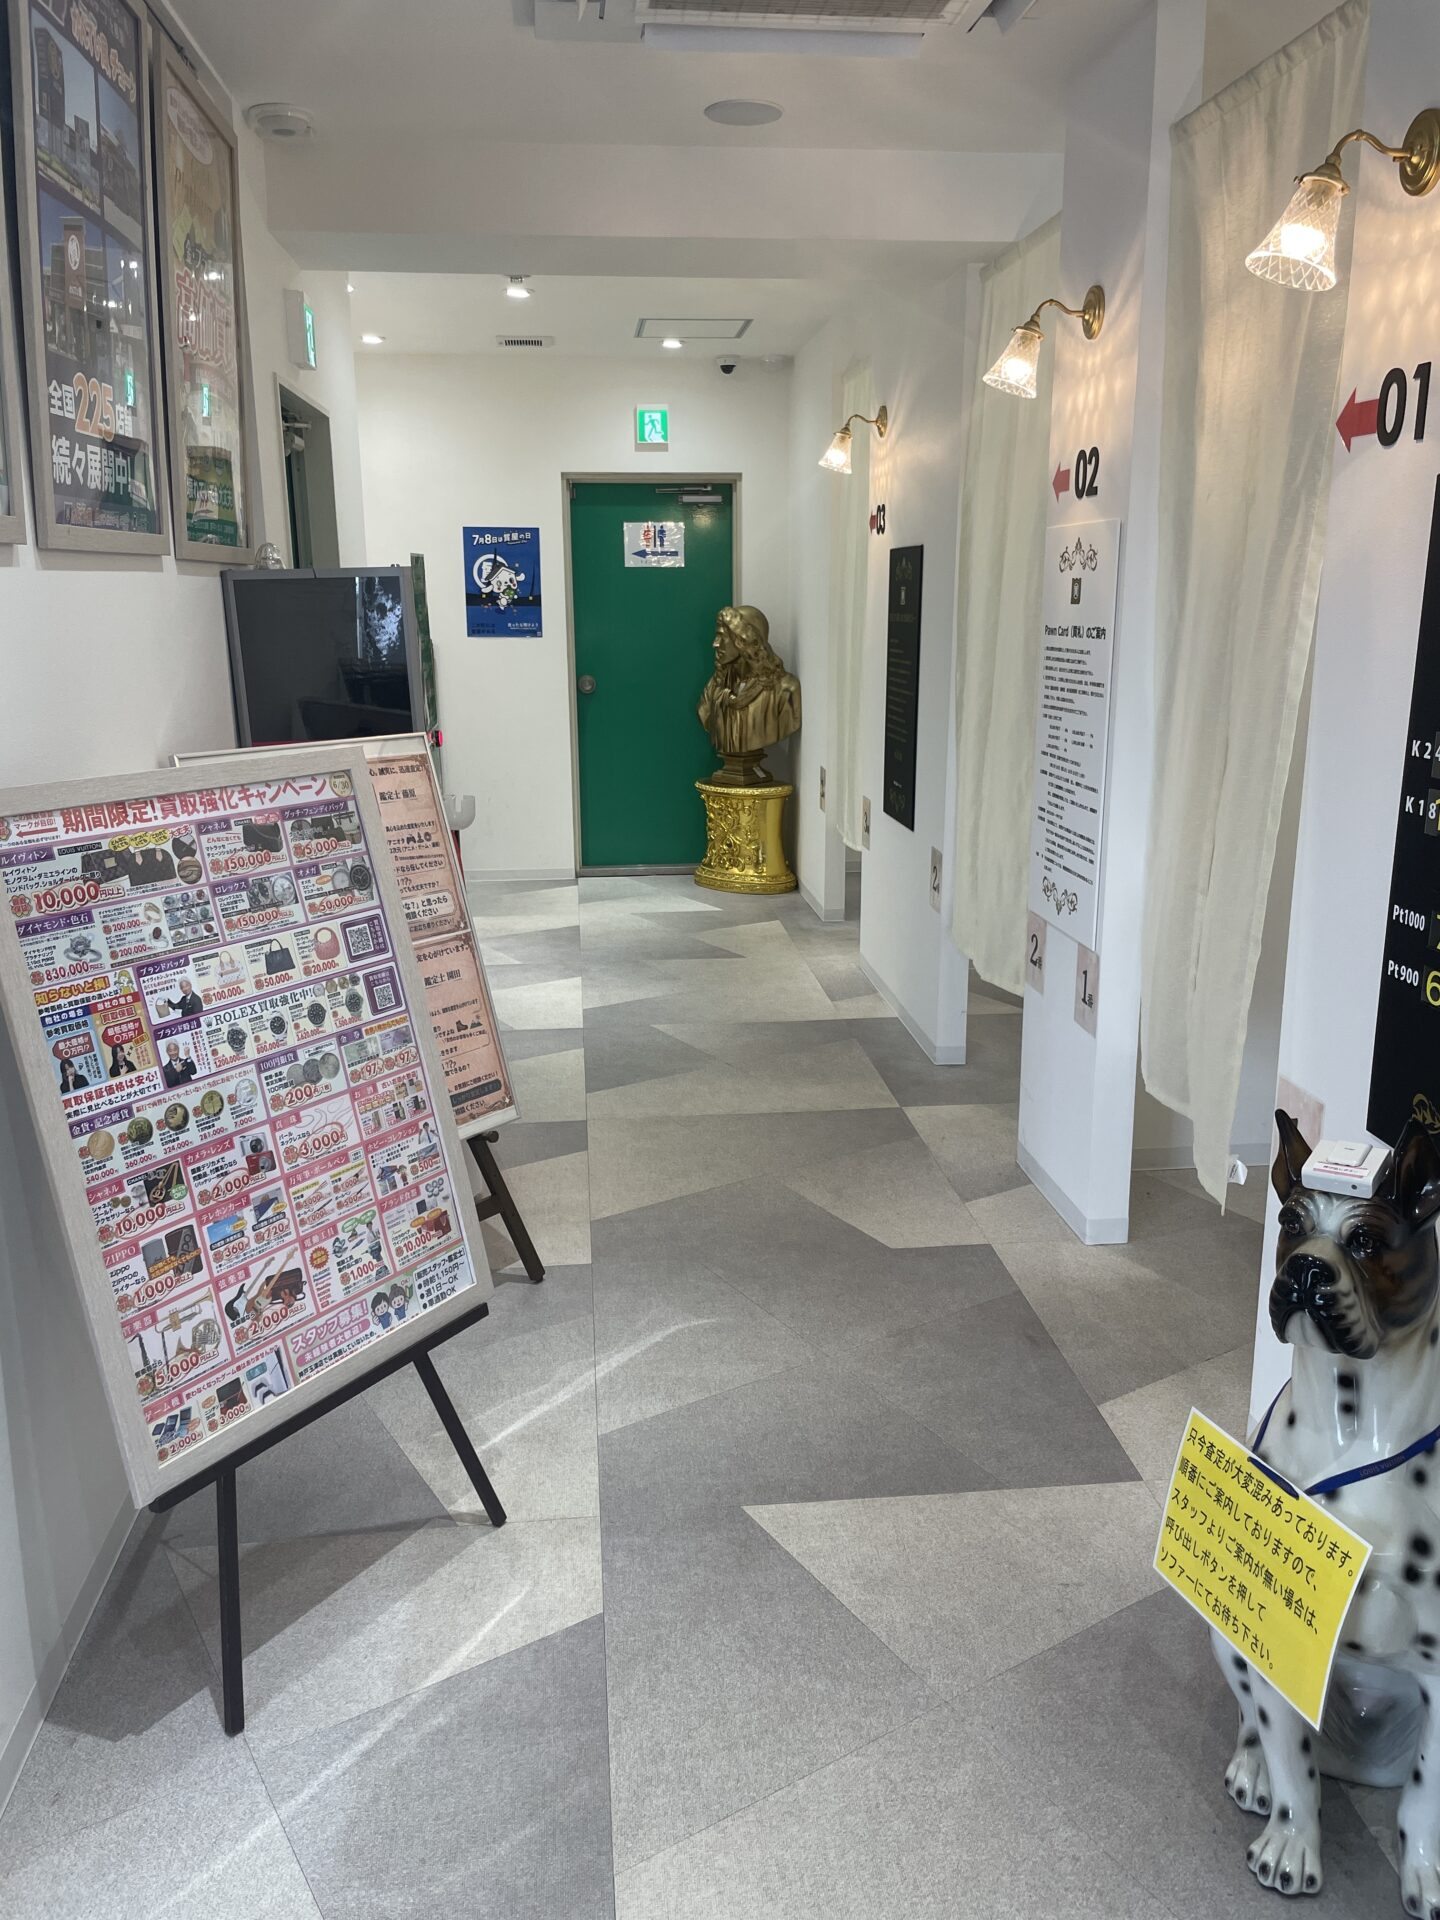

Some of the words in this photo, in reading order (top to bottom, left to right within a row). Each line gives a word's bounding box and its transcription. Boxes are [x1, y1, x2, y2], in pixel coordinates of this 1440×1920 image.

[1377, 361, 1431, 447] 01
[1075, 447, 1100, 499] 02
[877, 504, 885, 535] 03
[1045, 625, 1057, 635] Pawn
[1058, 626, 1069, 637] Card
[61, 775, 327, 835] 期間限定!買取強化キャンペーン
[200, 820, 229, 832] シャネル
[0, 849, 48, 866] ルイヴィトン
[59, 846, 75, 854] LOUIS
[76, 841, 102, 852] VUITTON
[2, 865, 37, 877] ルイヴィトン
[4, 867, 78, 886] モノグラム・ダミエラインの
[297, 866, 316, 877] オメガ
[214, 880, 247, 894] ロレックス
[16, 912, 89, 938] ダイヤモンド・色石
[1393, 904, 1425, 931] Pt1000
[140, 957, 186, 976] ブランドバッグ
[34, 974, 111, 1006] 知らないと損!
[44, 1007, 84, 1025] 他社の場合
[96, 994, 133, 1011] 当社の場合
[45, 1018, 89, 1038] 参考買取価格
[157, 1019, 198, 1039] ブランド時計
[61, 1069, 159, 1110] 買取保証価格は安心!
[65, 1082, 161, 1120] 実際に見比べることが大切です!
[70, 1107, 130, 1136] 金貨・記念硬貨
[185, 1139, 231, 1164] カメラ・レンズ
[366, 1124, 417, 1152] ホビー・コレクション
[88, 1183, 119, 1201] シャネル
[200, 1196, 247, 1223] テレホンカード
[103, 1244, 136, 1266] ZIPPO
[112, 1275, 146, 1295] ライターなら
[290, 1298, 368, 1354] スタッフ募集!
[303, 1323, 363, 1362] 未経験者大歓迎!
[1186, 1427, 1354, 1578] 只今査定が大変混みあっております。
[1178, 1455, 1318, 1592] 順番にご案内しておりますので、
[1165, 1516, 1267, 1622] 呼び出しボタンを押して
[1171, 1487, 1318, 1635] スタッフよりご案内が無い場合は、
[1161, 1547, 1273, 1669] ソファーにてお待ち下さい。
